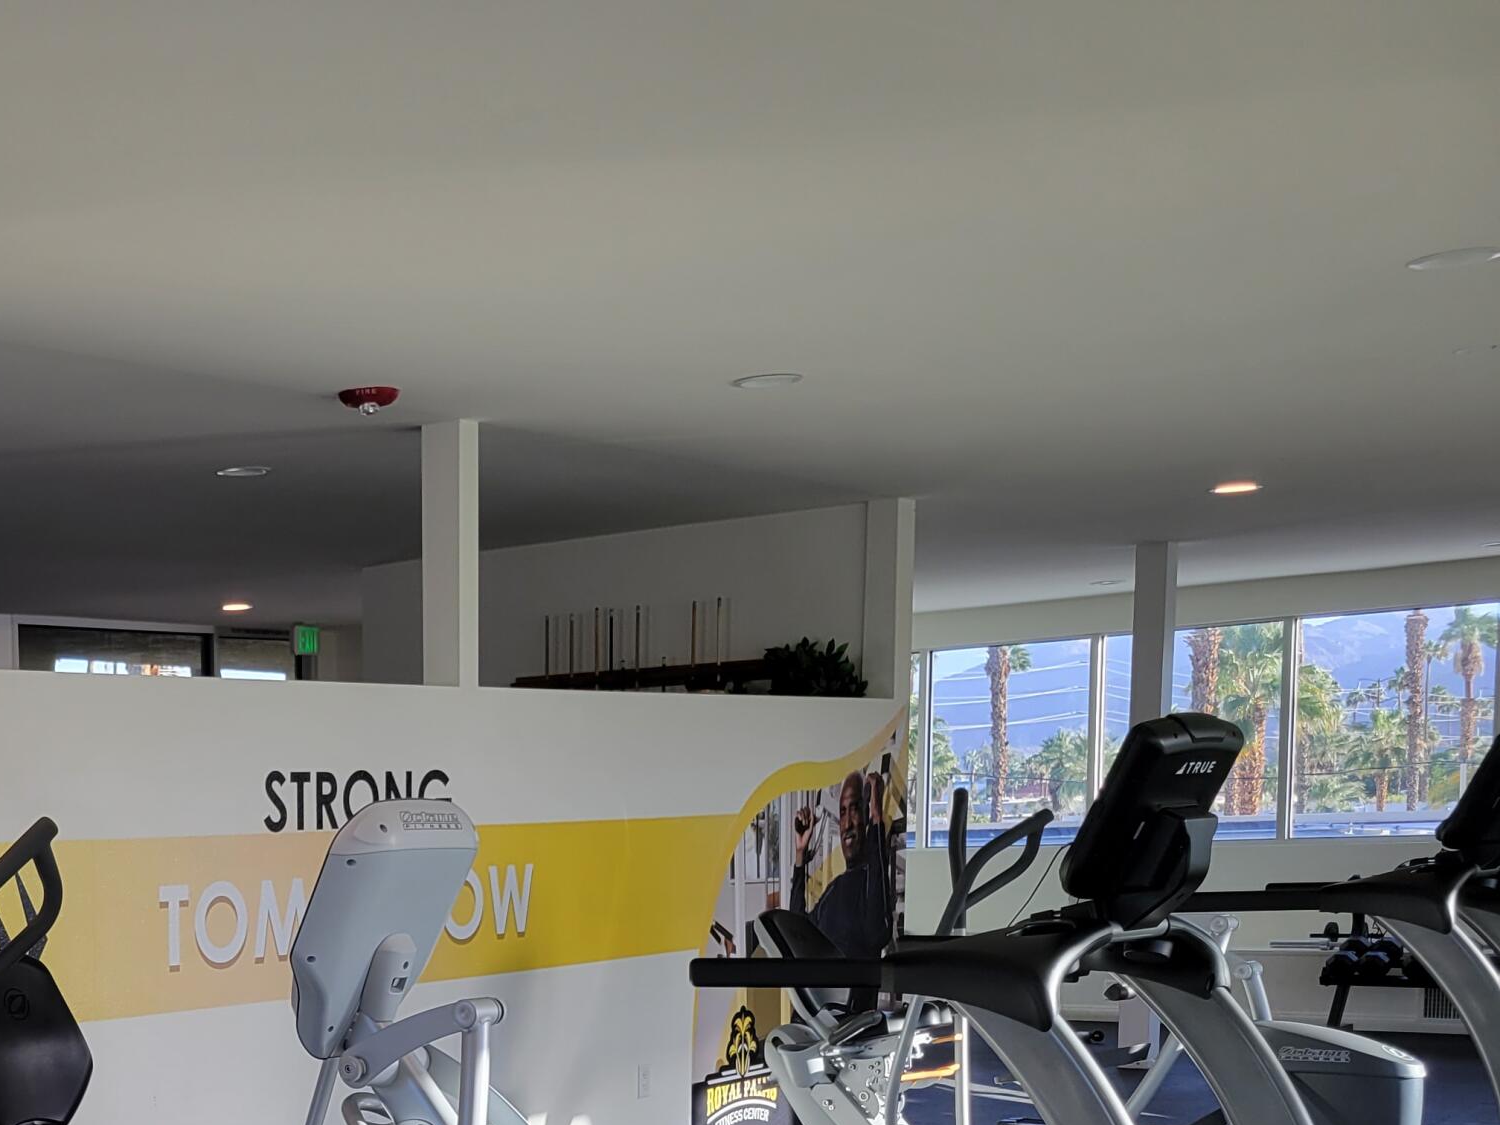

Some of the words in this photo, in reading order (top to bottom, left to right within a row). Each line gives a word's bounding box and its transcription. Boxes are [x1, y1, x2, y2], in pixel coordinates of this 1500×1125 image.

[1186, 761, 1217, 775] TRUE
[159, 863, 534, 972] TOMOW
[706, 1082, 743, 1118] ROYAL
[743, 1108, 770, 1122] CENTER
